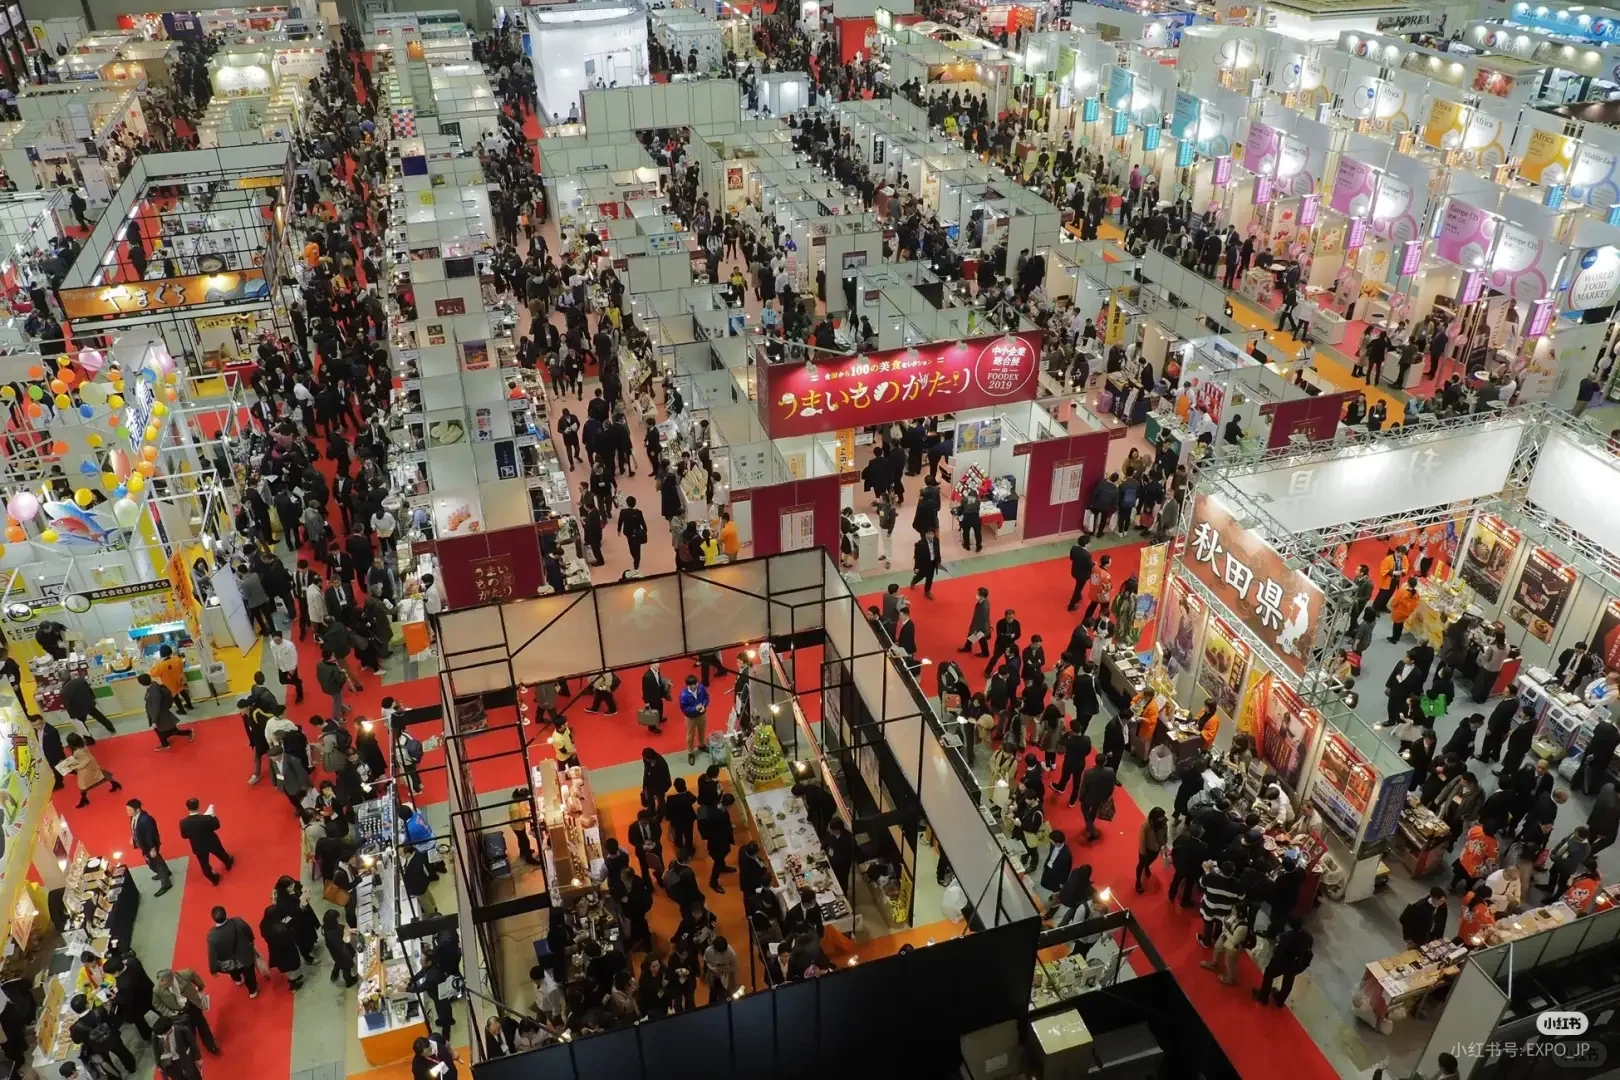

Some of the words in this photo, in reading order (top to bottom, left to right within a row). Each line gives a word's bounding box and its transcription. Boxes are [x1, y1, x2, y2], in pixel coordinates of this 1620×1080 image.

[1396, 15, 1430, 27] KOREA
[1435, 100, 1452, 113] Africa
[1475, 116, 1493, 129] Africa
[1534, 131, 1555, 145] Africa
[1449, 204, 1468, 218] Europe
[1505, 232, 1526, 247] Europe
[1527, 240, 1538, 251] CIS
[1584, 281, 1607, 291] FOOD
[100, 281, 187, 313] やまぐち
[1577, 289, 1612, 301] MARKET
[993, 356, 1021, 366] 総合展
[987, 372, 1019, 381] FOODEX
[988, 380, 1012, 390] 2019
[778, 367, 971, 420] うまいものがたり
[1191, 522, 1284, 631] 秋田県
